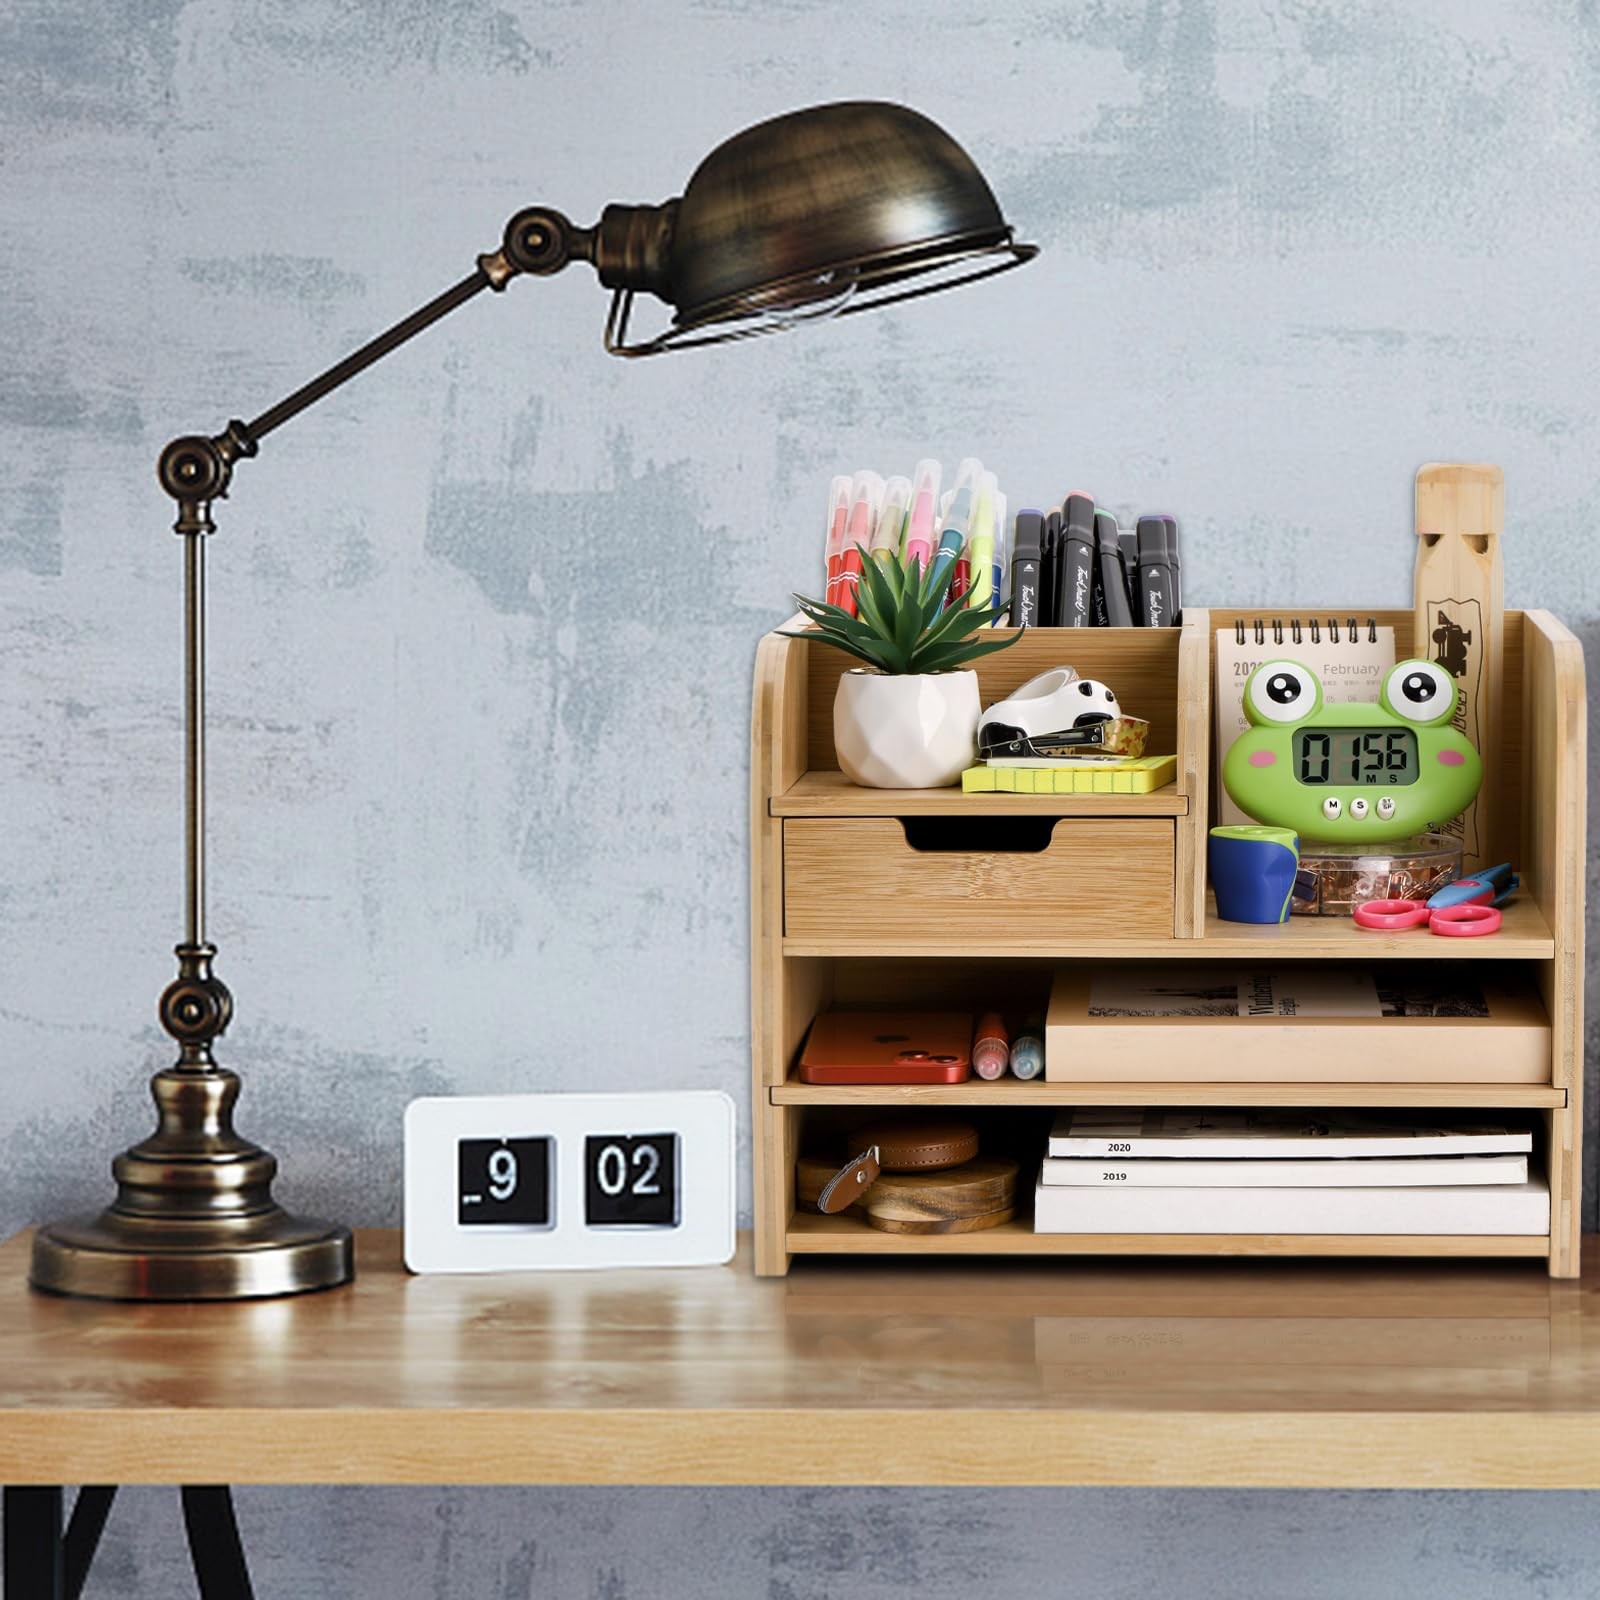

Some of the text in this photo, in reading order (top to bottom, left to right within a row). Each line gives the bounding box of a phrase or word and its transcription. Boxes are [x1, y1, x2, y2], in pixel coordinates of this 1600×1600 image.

[1234, 661, 1263, 676] 202
[1323, 664, 1380, 676] February
[1366, 774, 1398, 783] M S
[1356, 801, 1364, 809] S
[1108, 1143, 1131, 1152] 2020
[488, 1145, 660, 1200] 9 02
[1103, 1172, 1127, 1181] 2019
